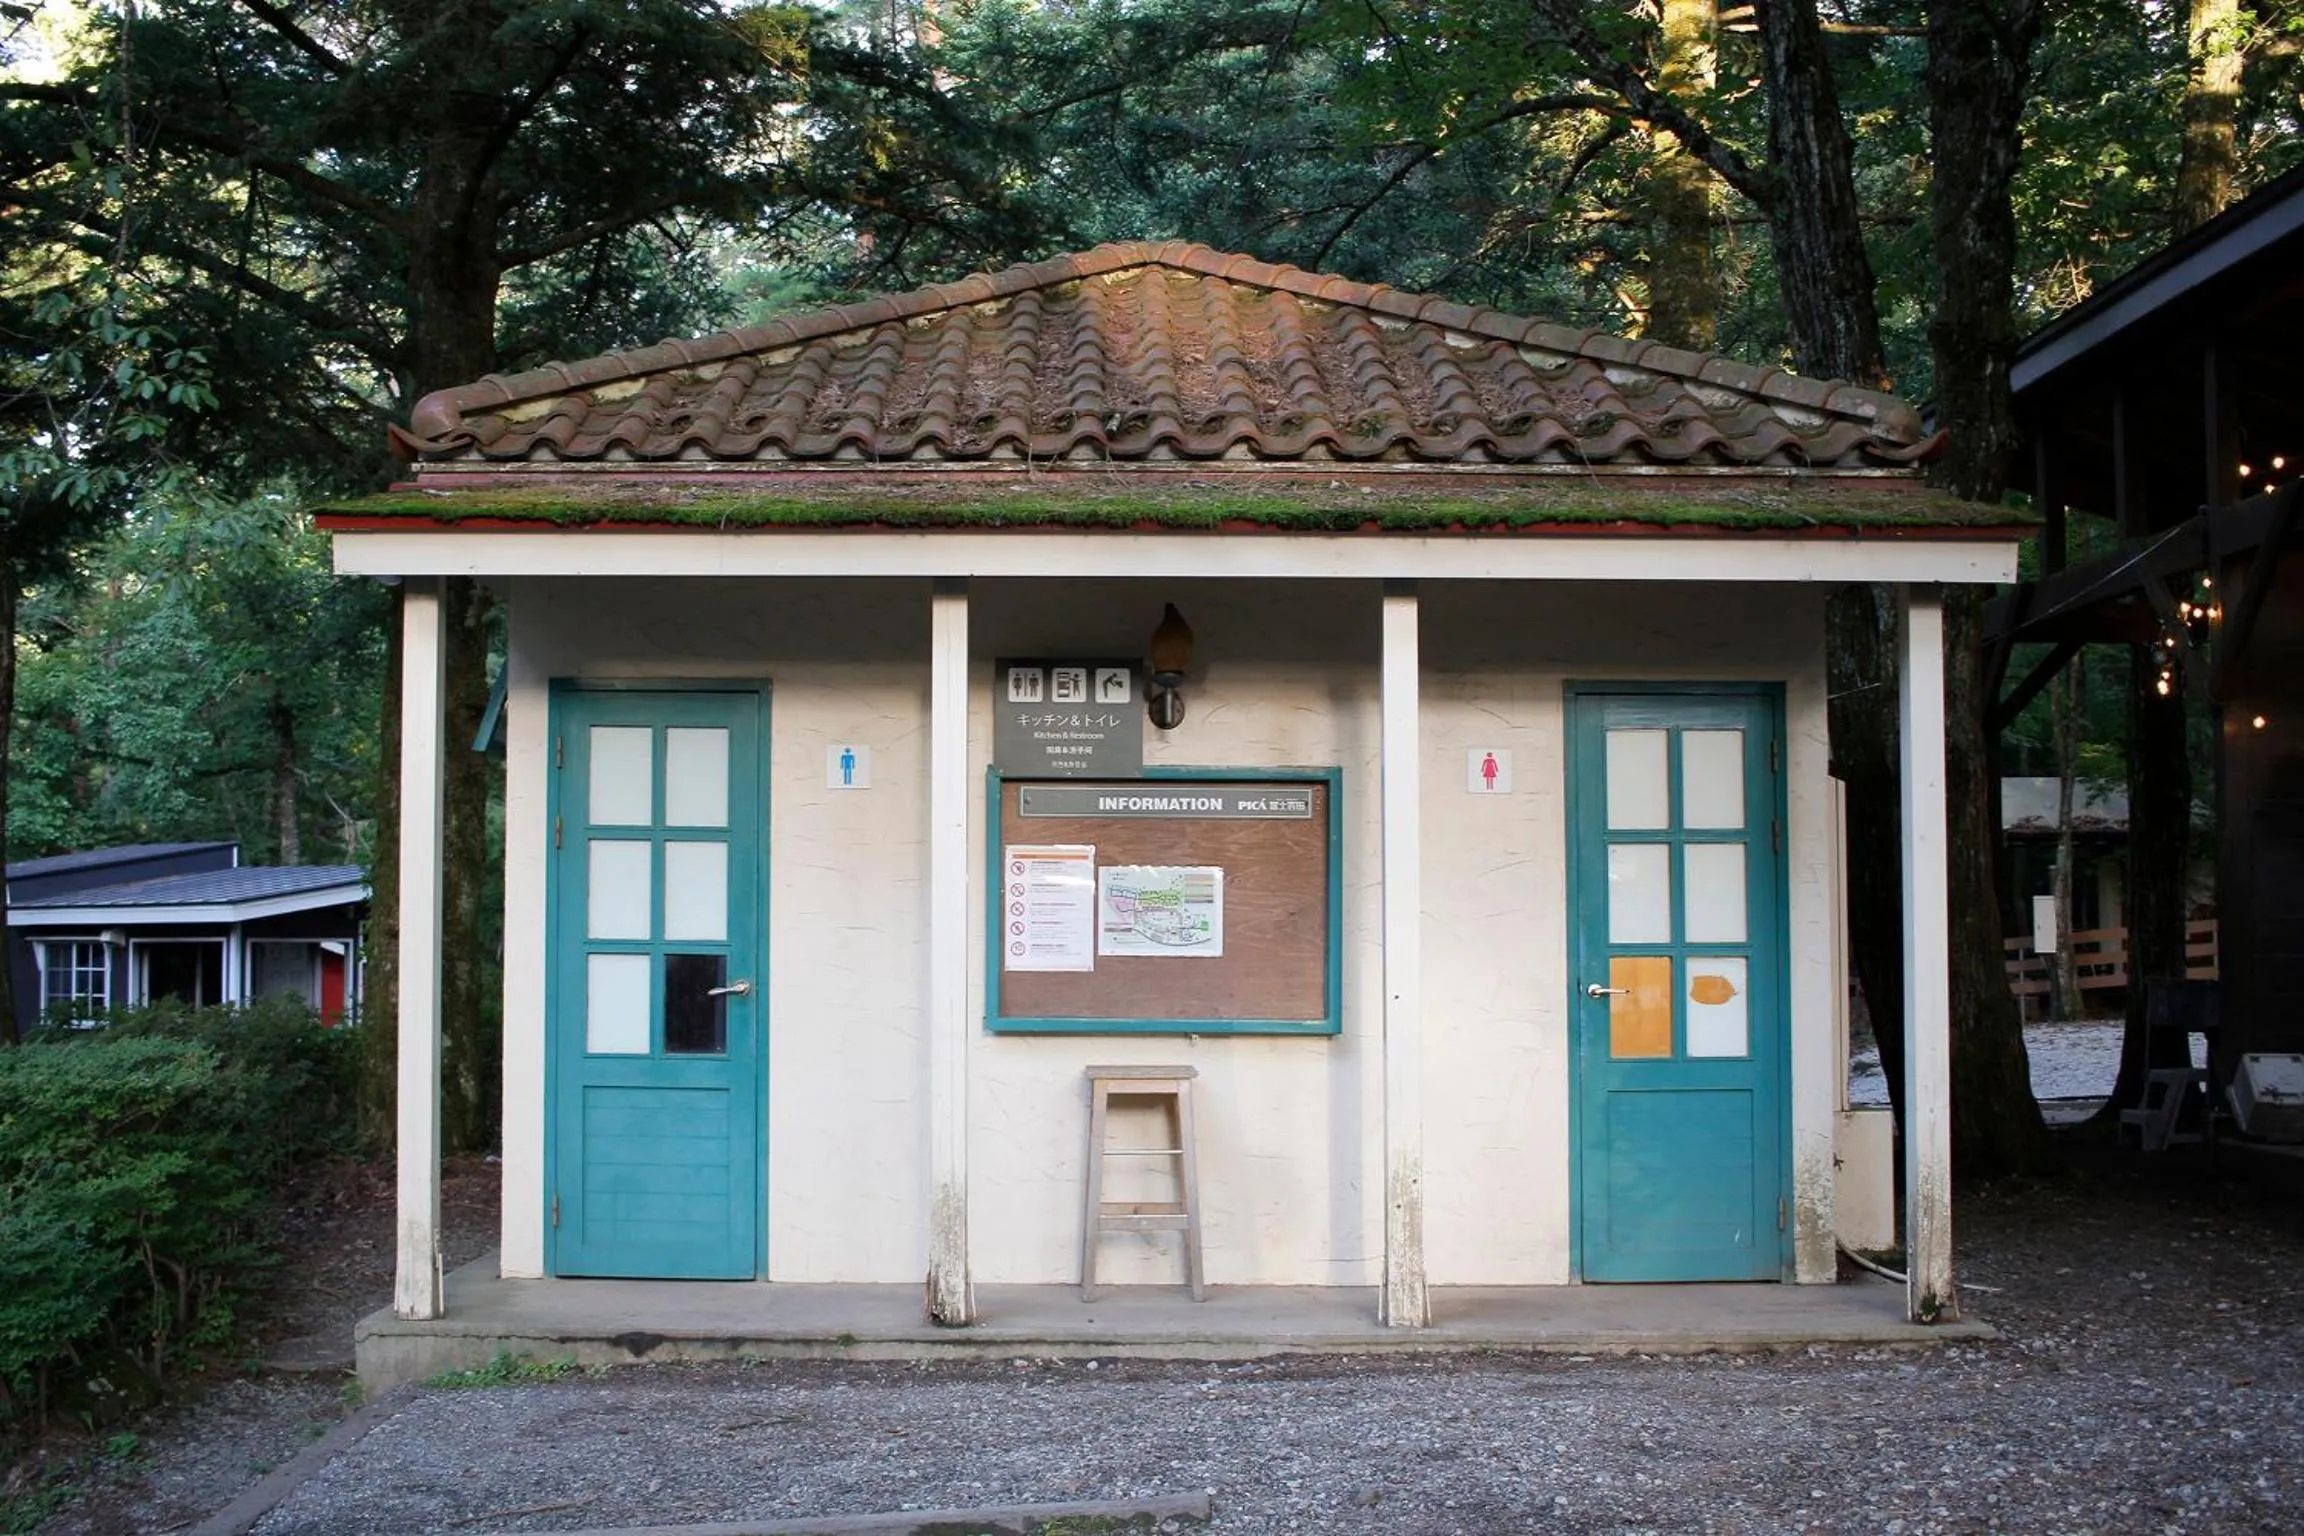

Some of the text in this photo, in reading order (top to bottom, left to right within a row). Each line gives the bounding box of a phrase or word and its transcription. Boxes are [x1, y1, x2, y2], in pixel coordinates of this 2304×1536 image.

[1017, 714, 1121, 728] キッチン&トイレ
[1034, 731, 1062, 740] Kitchen
[1062, 731, 1069, 740] &
[1098, 797, 1223, 810] INFORMATION
